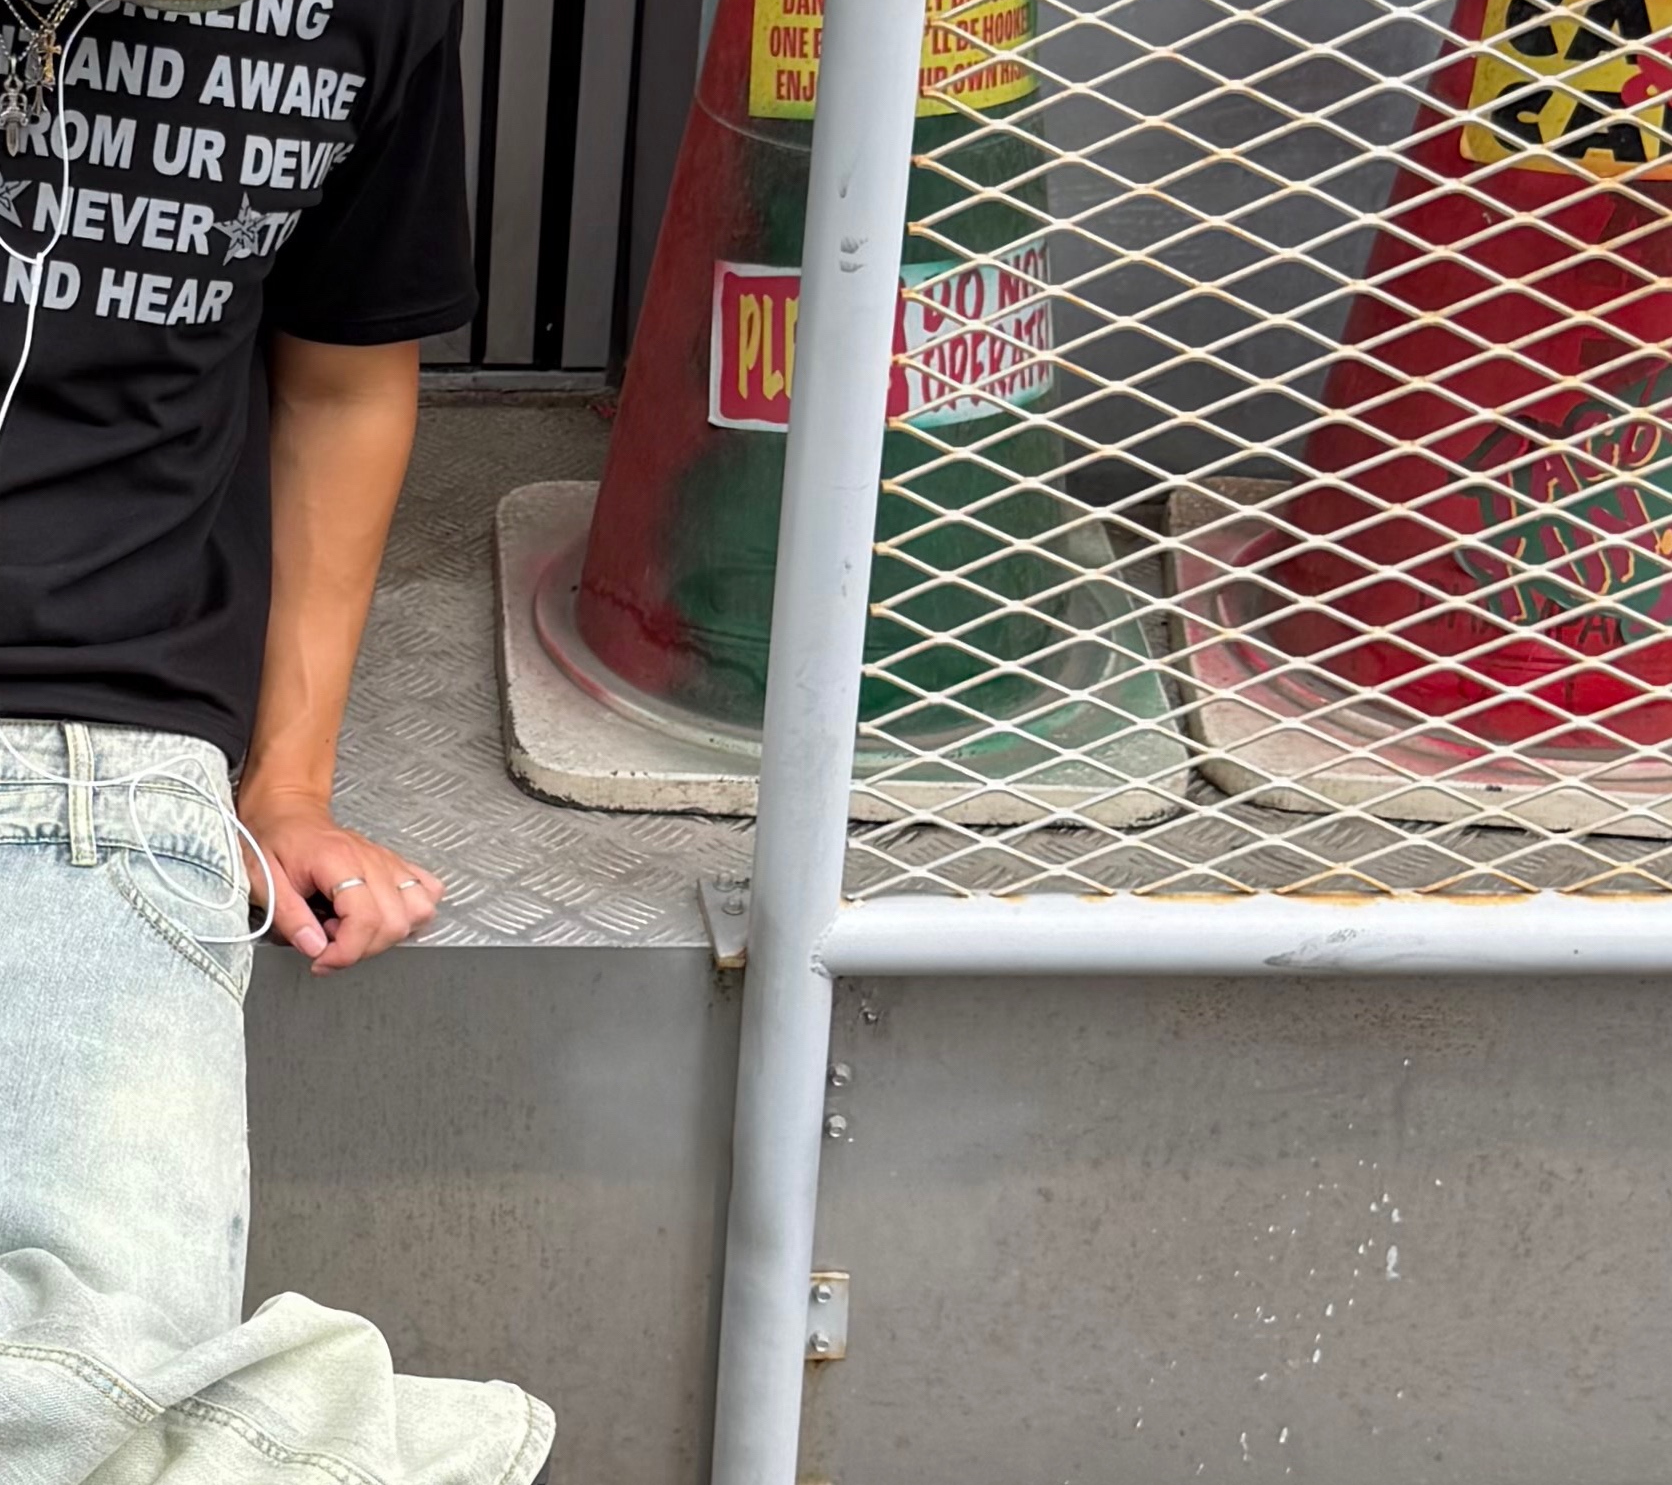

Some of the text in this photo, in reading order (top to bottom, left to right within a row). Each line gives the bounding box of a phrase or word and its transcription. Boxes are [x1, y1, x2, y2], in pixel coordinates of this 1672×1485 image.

[770, 27, 809, 59] ONE
[65, 37, 185, 99] AND
[199, 55, 366, 120] AWARE
[152, 123, 226, 182] UR
[32, 182, 215, 256] NEVER
[95, 268, 233, 326] HEAR
